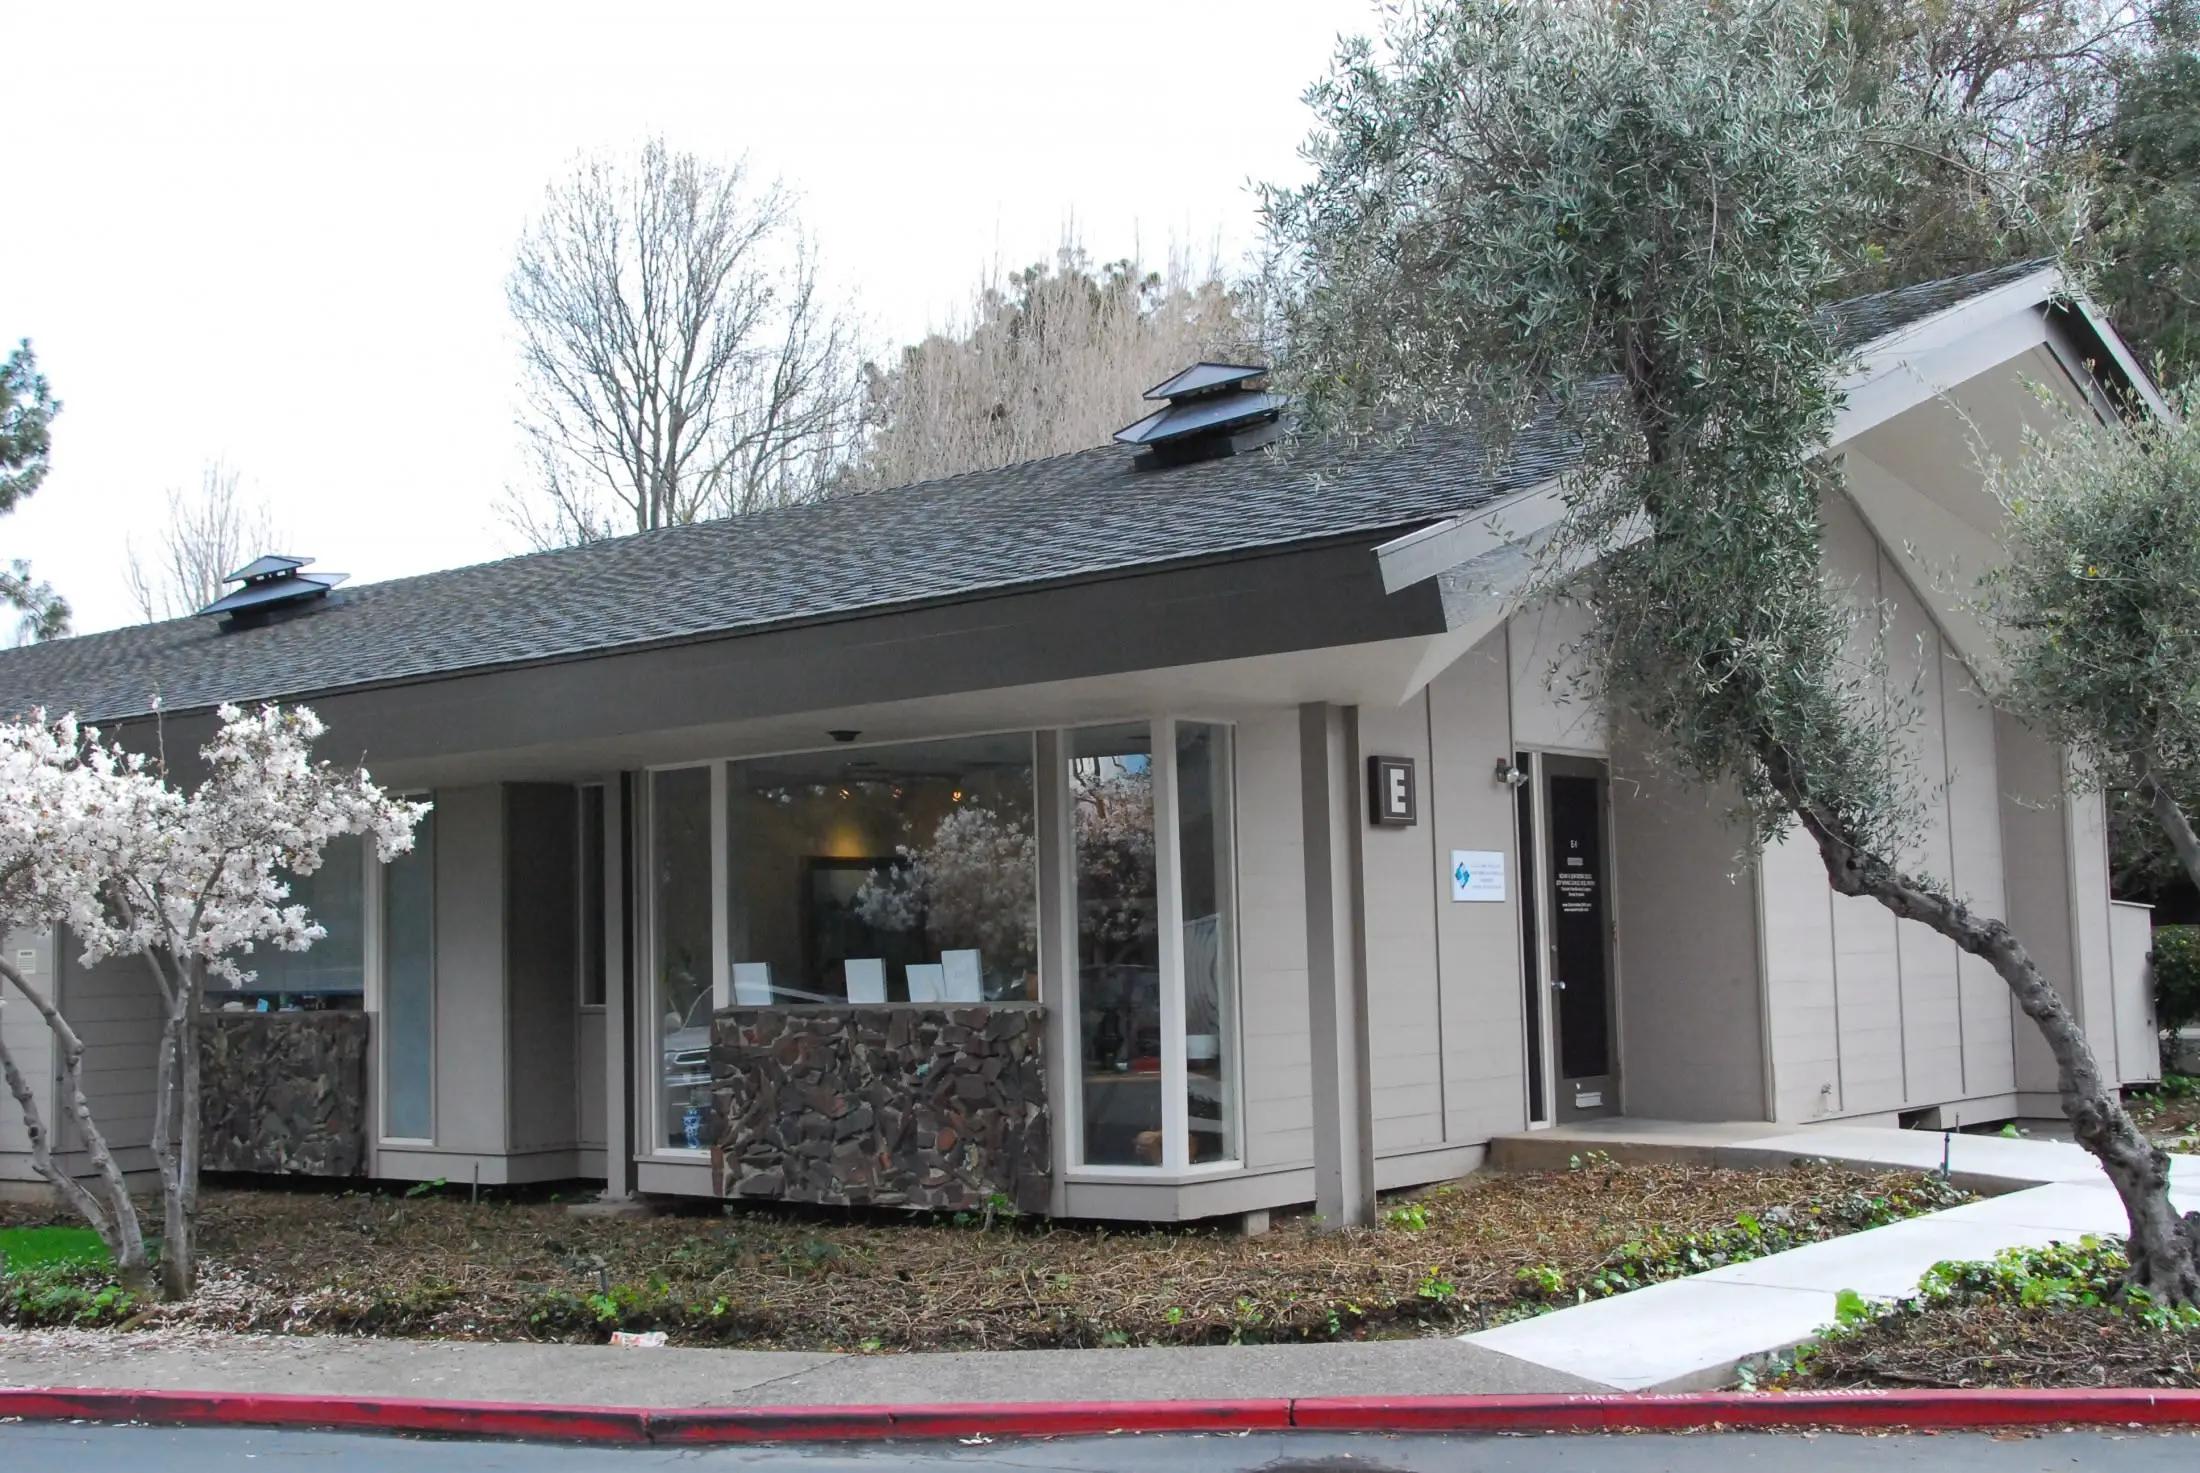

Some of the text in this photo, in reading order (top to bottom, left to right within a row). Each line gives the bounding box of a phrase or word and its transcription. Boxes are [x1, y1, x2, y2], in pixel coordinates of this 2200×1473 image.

[1389, 768, 1406, 813] E
[1636, 1393, 1703, 1401] LANE
[1784, 1388, 1889, 1397] PARKING
